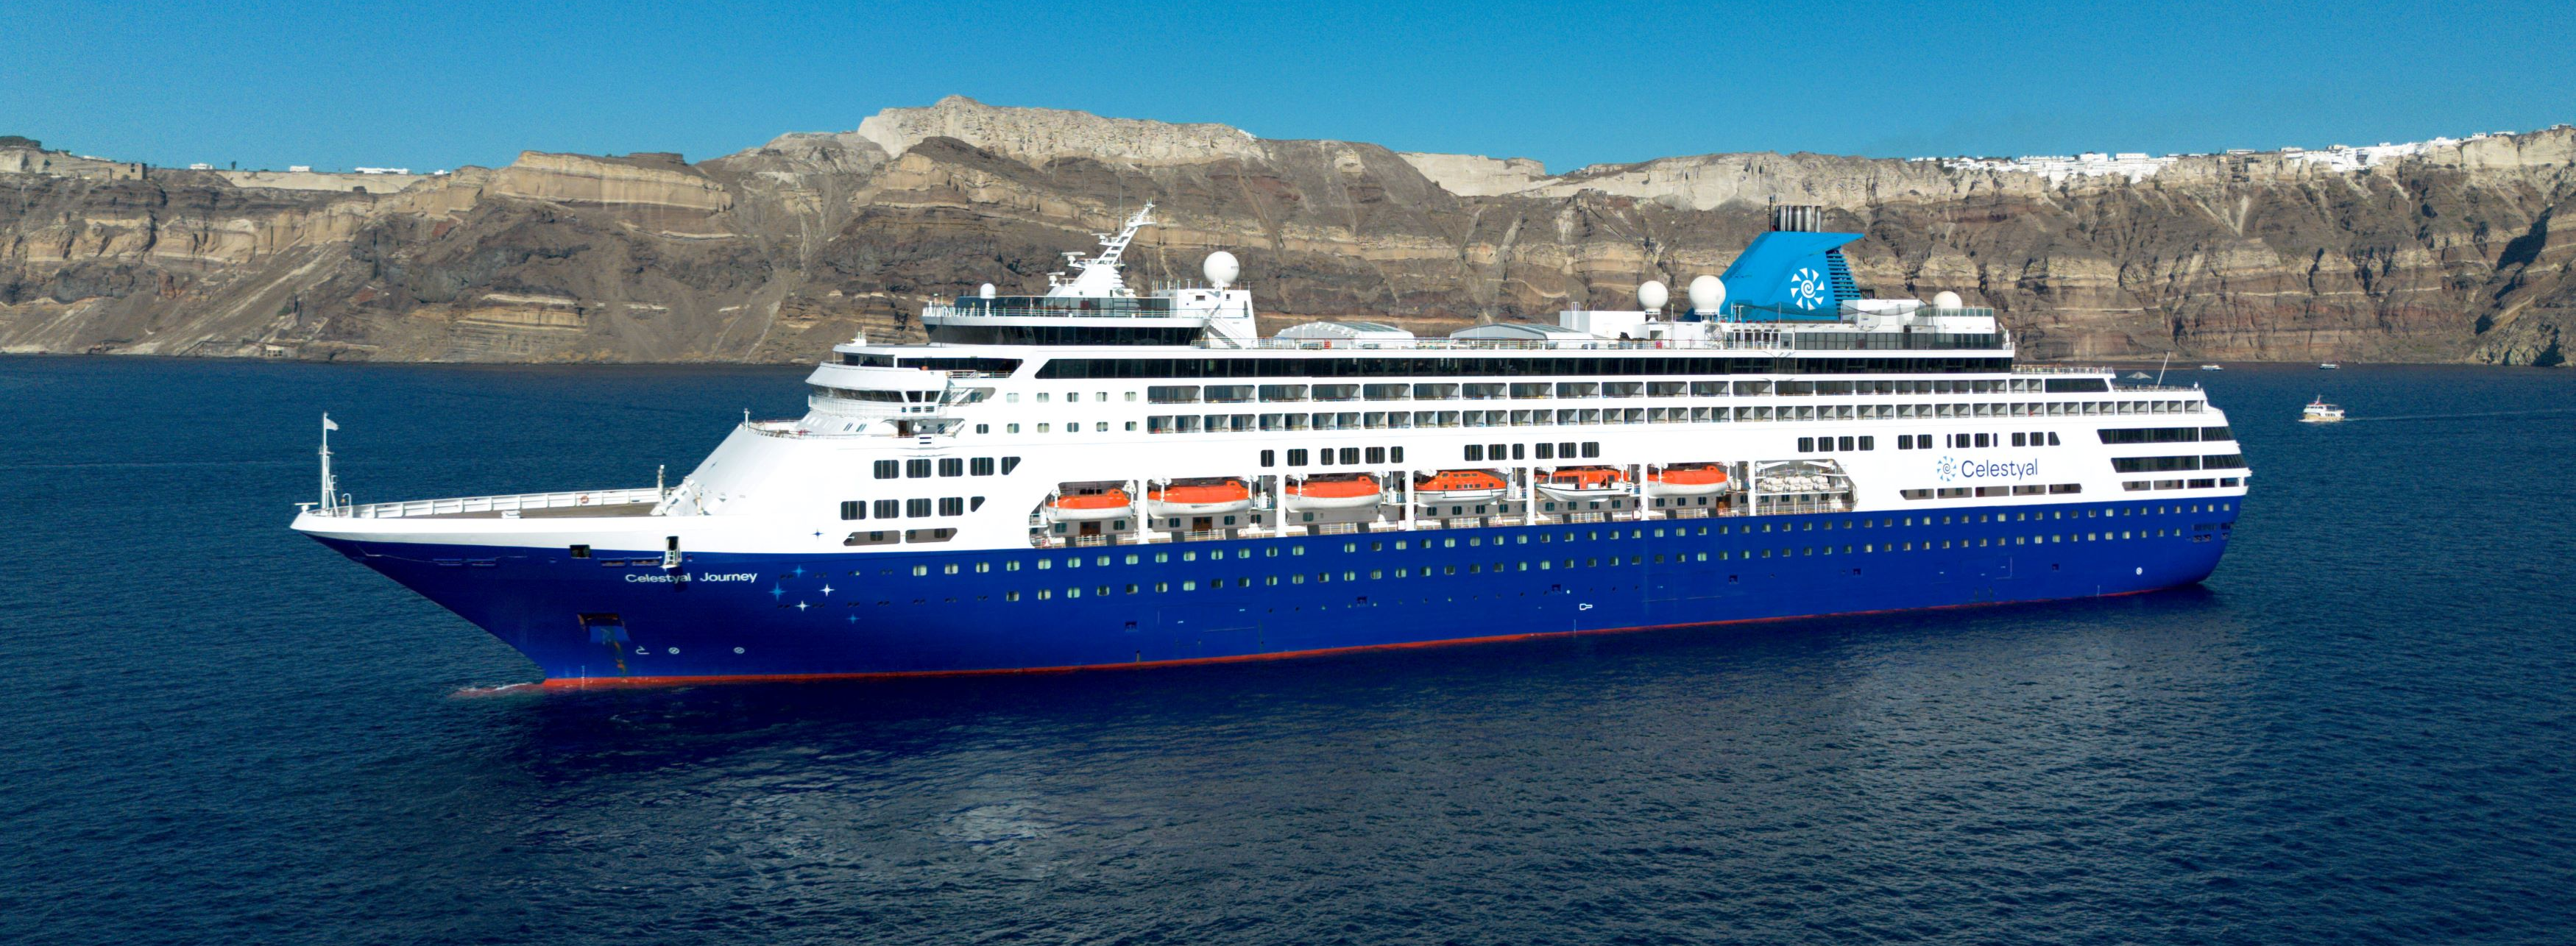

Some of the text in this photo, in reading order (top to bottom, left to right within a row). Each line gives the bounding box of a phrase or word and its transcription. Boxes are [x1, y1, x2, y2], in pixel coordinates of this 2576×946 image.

[1961, 458, 2038, 480] Celestyal
[625, 572, 758, 584] Celestyal Journey
